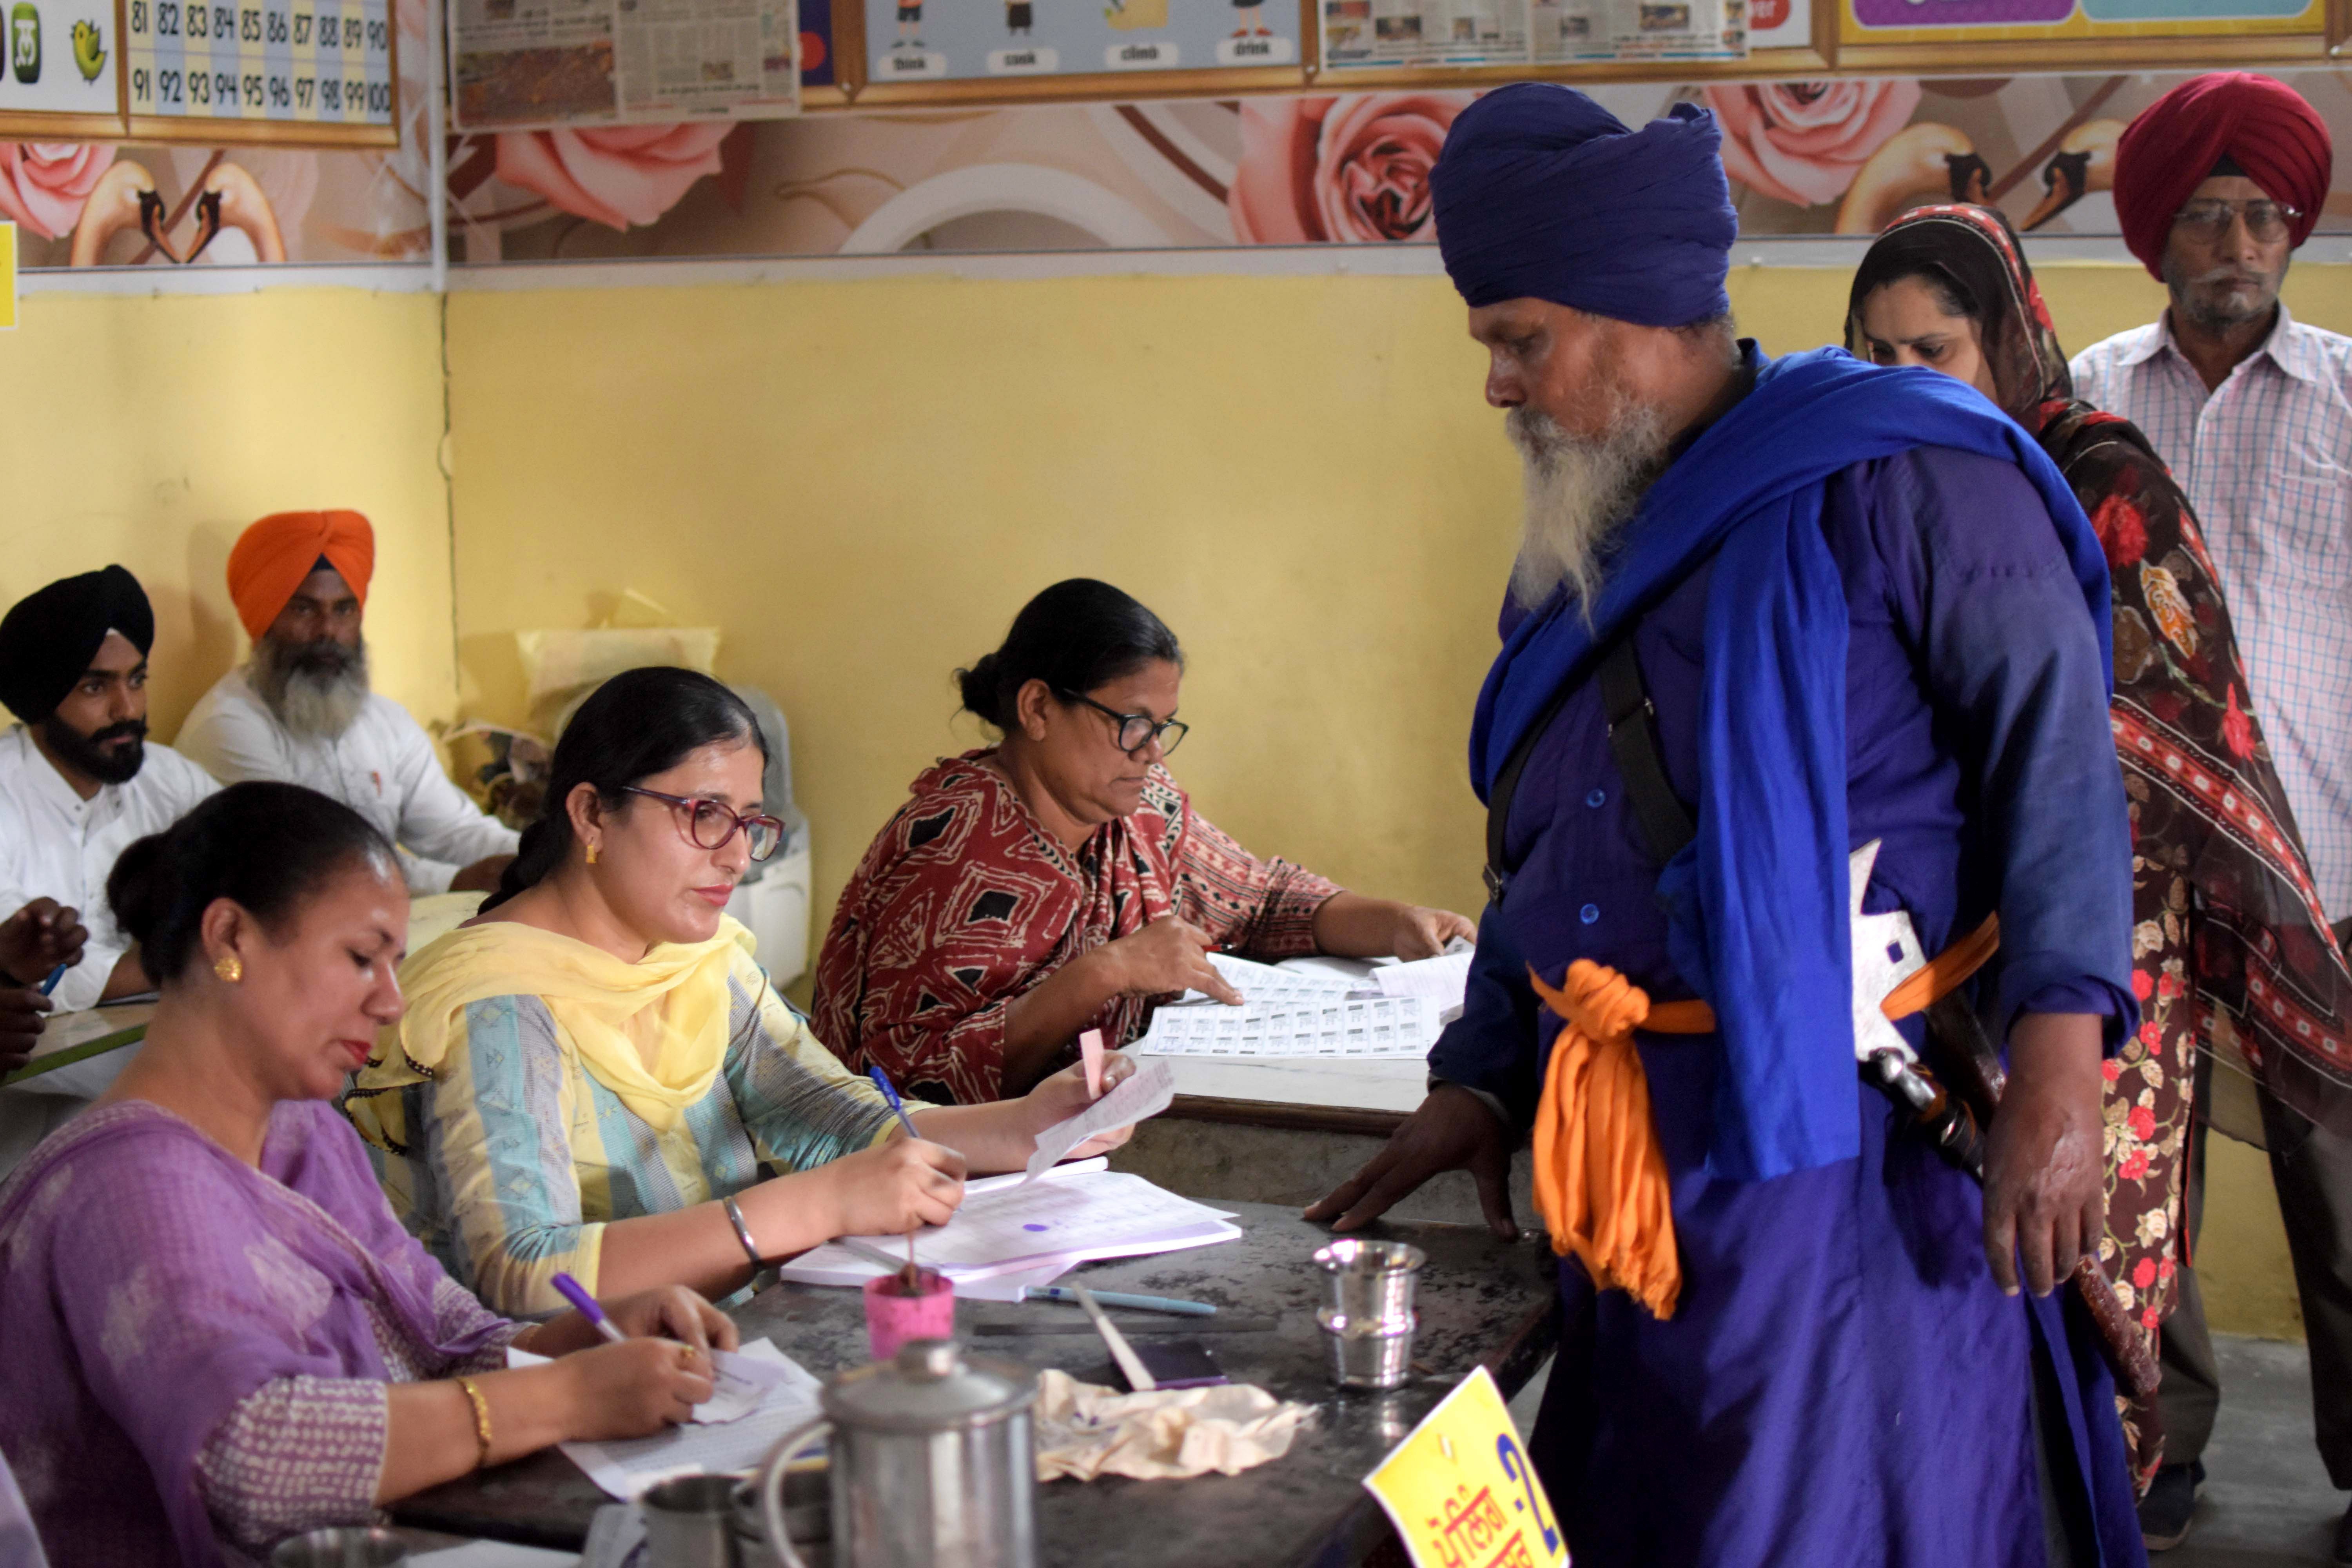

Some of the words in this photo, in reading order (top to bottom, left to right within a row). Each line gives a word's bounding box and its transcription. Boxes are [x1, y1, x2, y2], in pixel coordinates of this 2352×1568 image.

[132, 0, 147, 34] 81
[158, 2, 179, 36] 82
[187, 4, 207, 38] 83
[214, 7, 234, 40] 84
[242, 9, 261, 42] 85
[267, 11, 287, 43] 86
[294, 13, 312, 45] 87
[319, 16, 338, 48] 88
[345, 18, 362, 49] 89
[366, 20, 387, 51] 90
[1121, 45, 1159, 61] climb
[1234, 39, 1270, 56] drink
[133, 68, 150, 101] 91
[159, 70, 181, 103] 92
[188, 71, 210, 104] 93
[215, 73, 238, 106] 94
[243, 74, 264, 107] 95
[269, 76, 290, 108] 96
[295, 77, 315, 110] 97
[321, 79, 340, 111] 98
[345, 80, 365, 112] 99
[367, 82, 391, 113] 100
